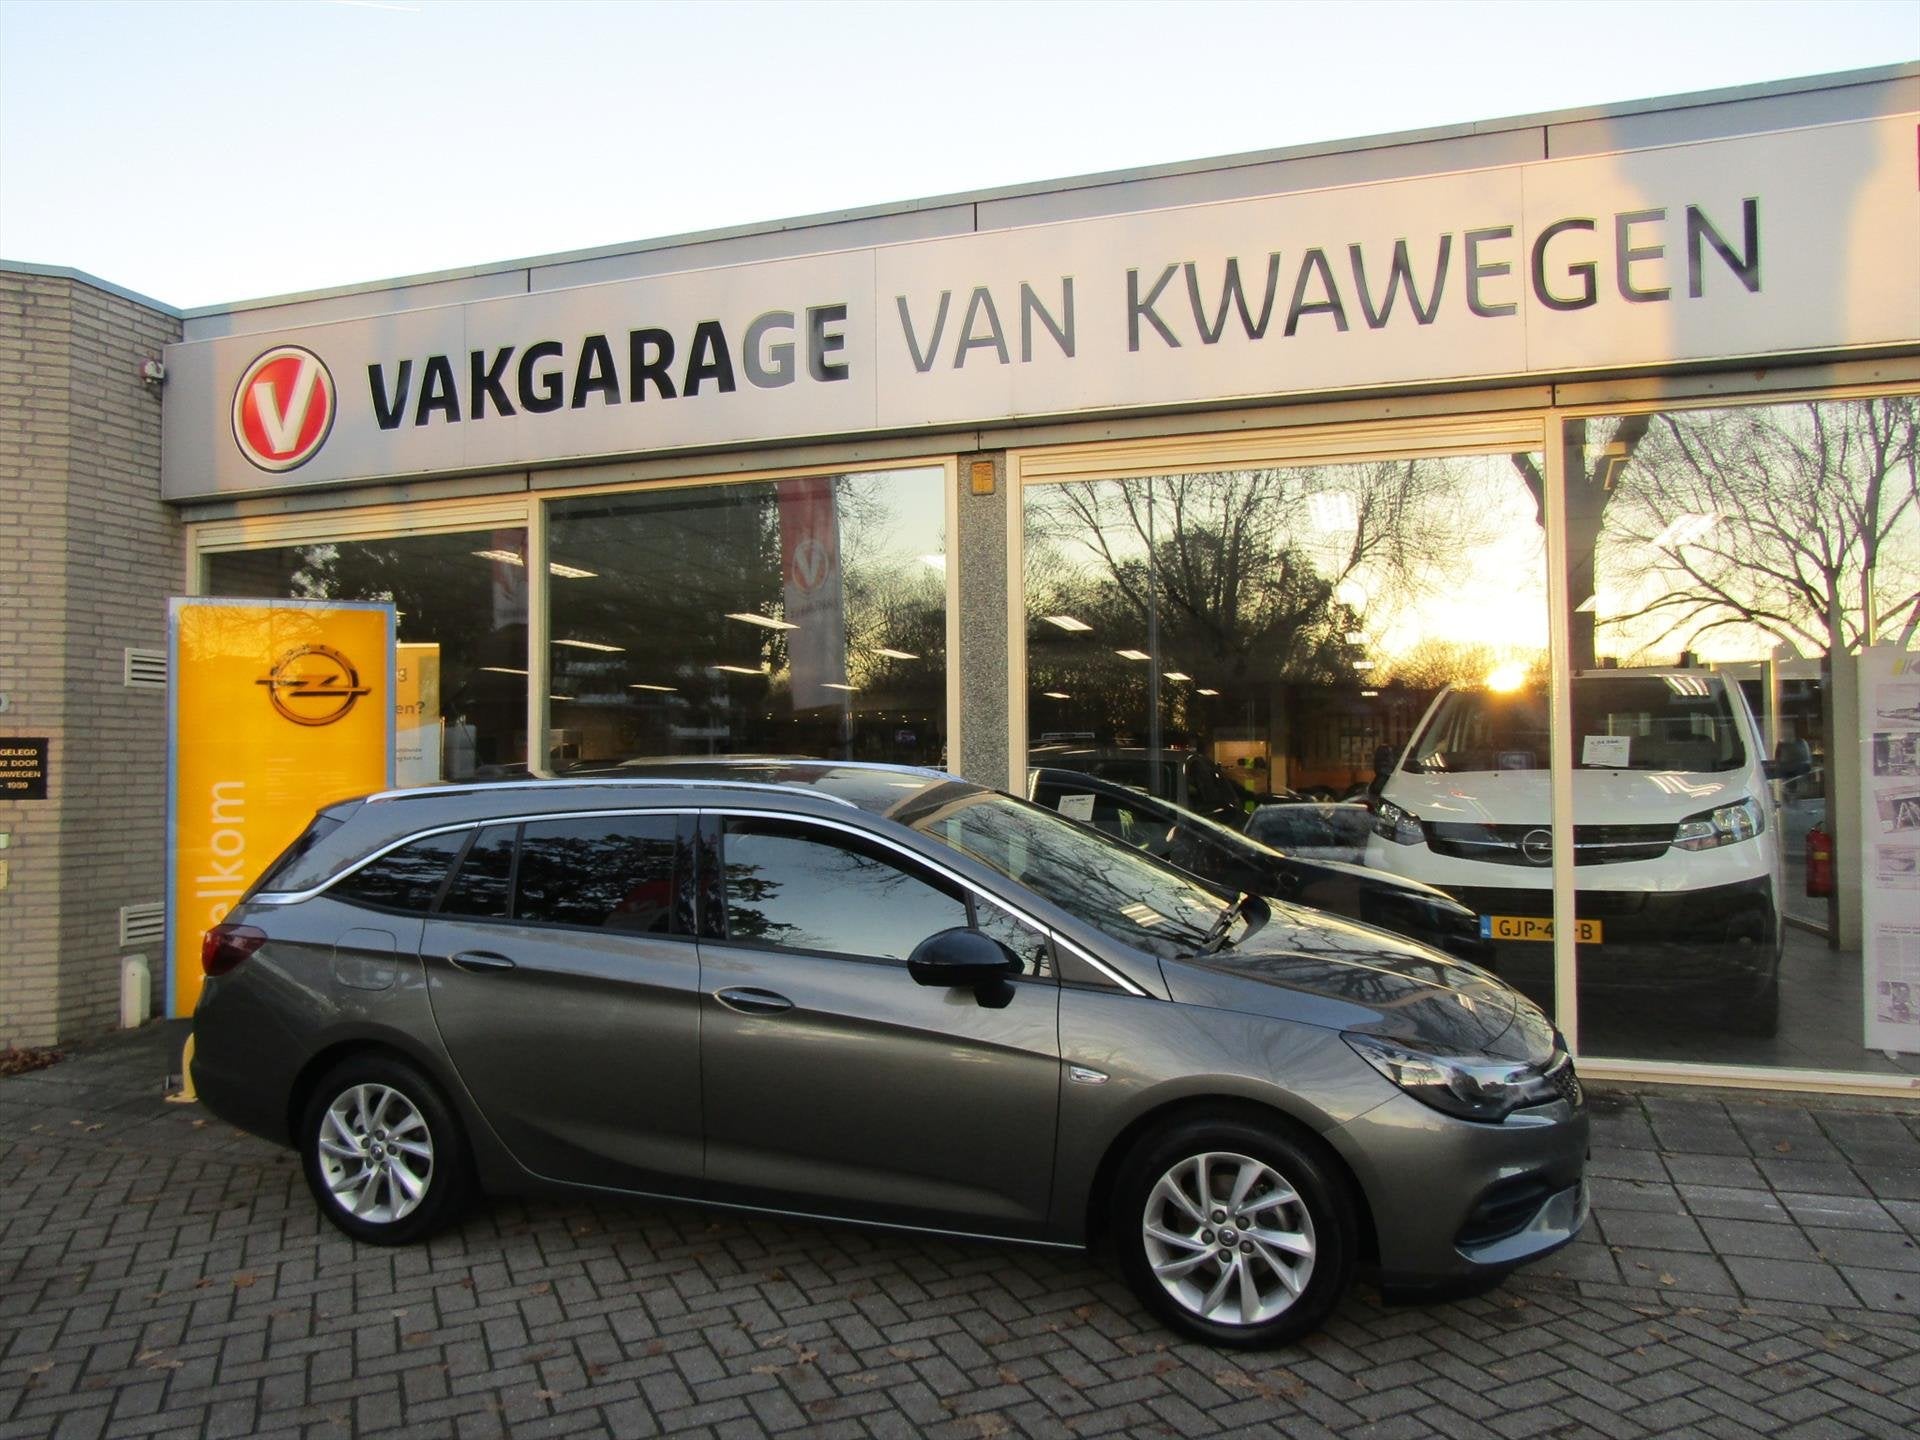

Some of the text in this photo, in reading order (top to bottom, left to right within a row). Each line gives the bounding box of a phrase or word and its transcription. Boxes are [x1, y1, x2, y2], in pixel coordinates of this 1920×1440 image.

[367, 196, 1761, 430] VAKGARAGE VAN KWAWEGEN
[11, 759, 38, 767] DOOR
[1498, 919, 1593, 941] GJP-4-B
